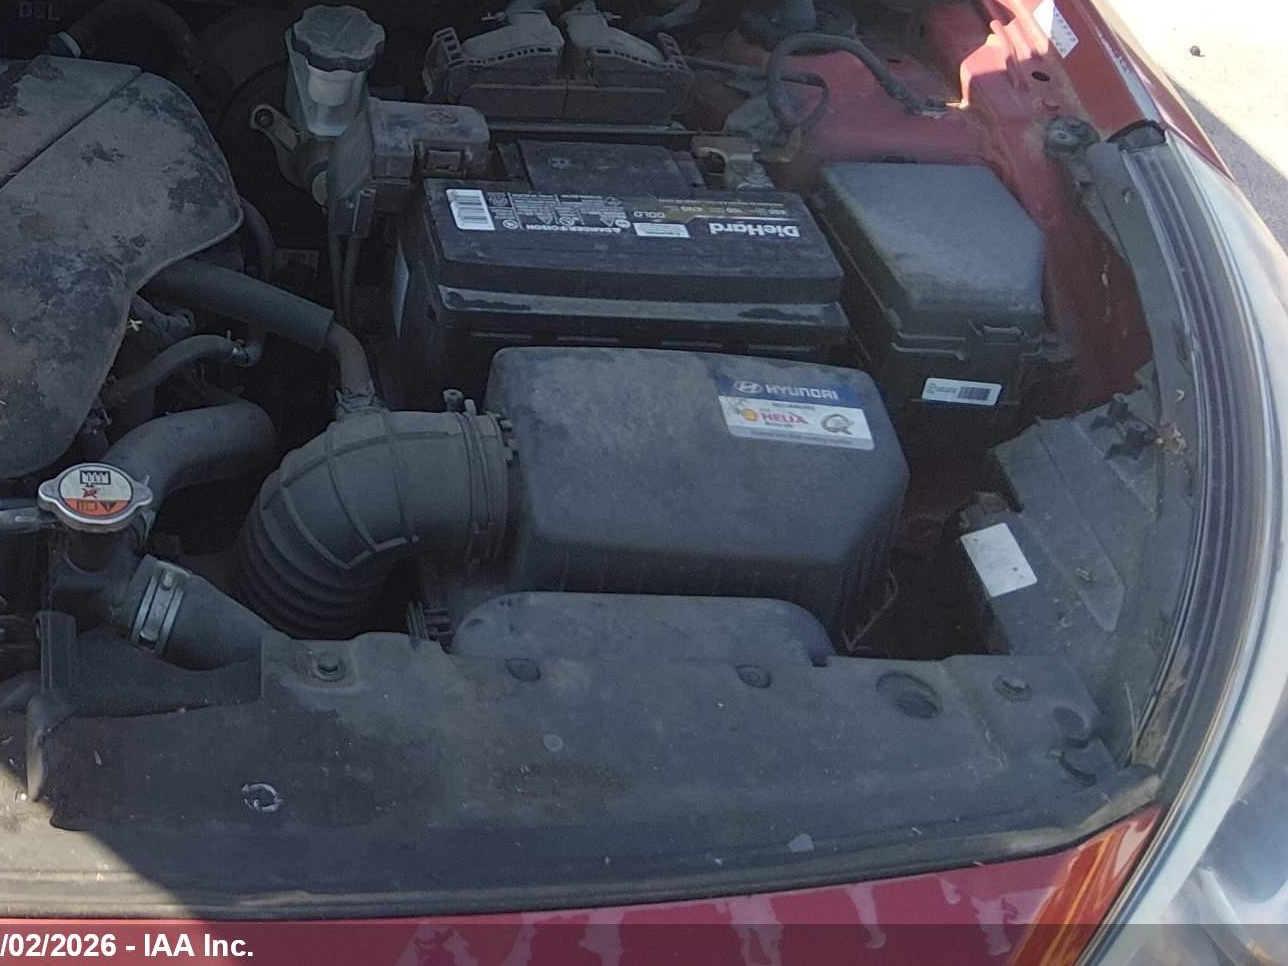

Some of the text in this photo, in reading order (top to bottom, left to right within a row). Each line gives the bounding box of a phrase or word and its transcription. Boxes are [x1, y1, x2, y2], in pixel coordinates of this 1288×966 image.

[708, 222, 802, 239] DieHard
[765, 385, 838, 400] HYUNDAI
[760, 412, 809, 425] HELIX
